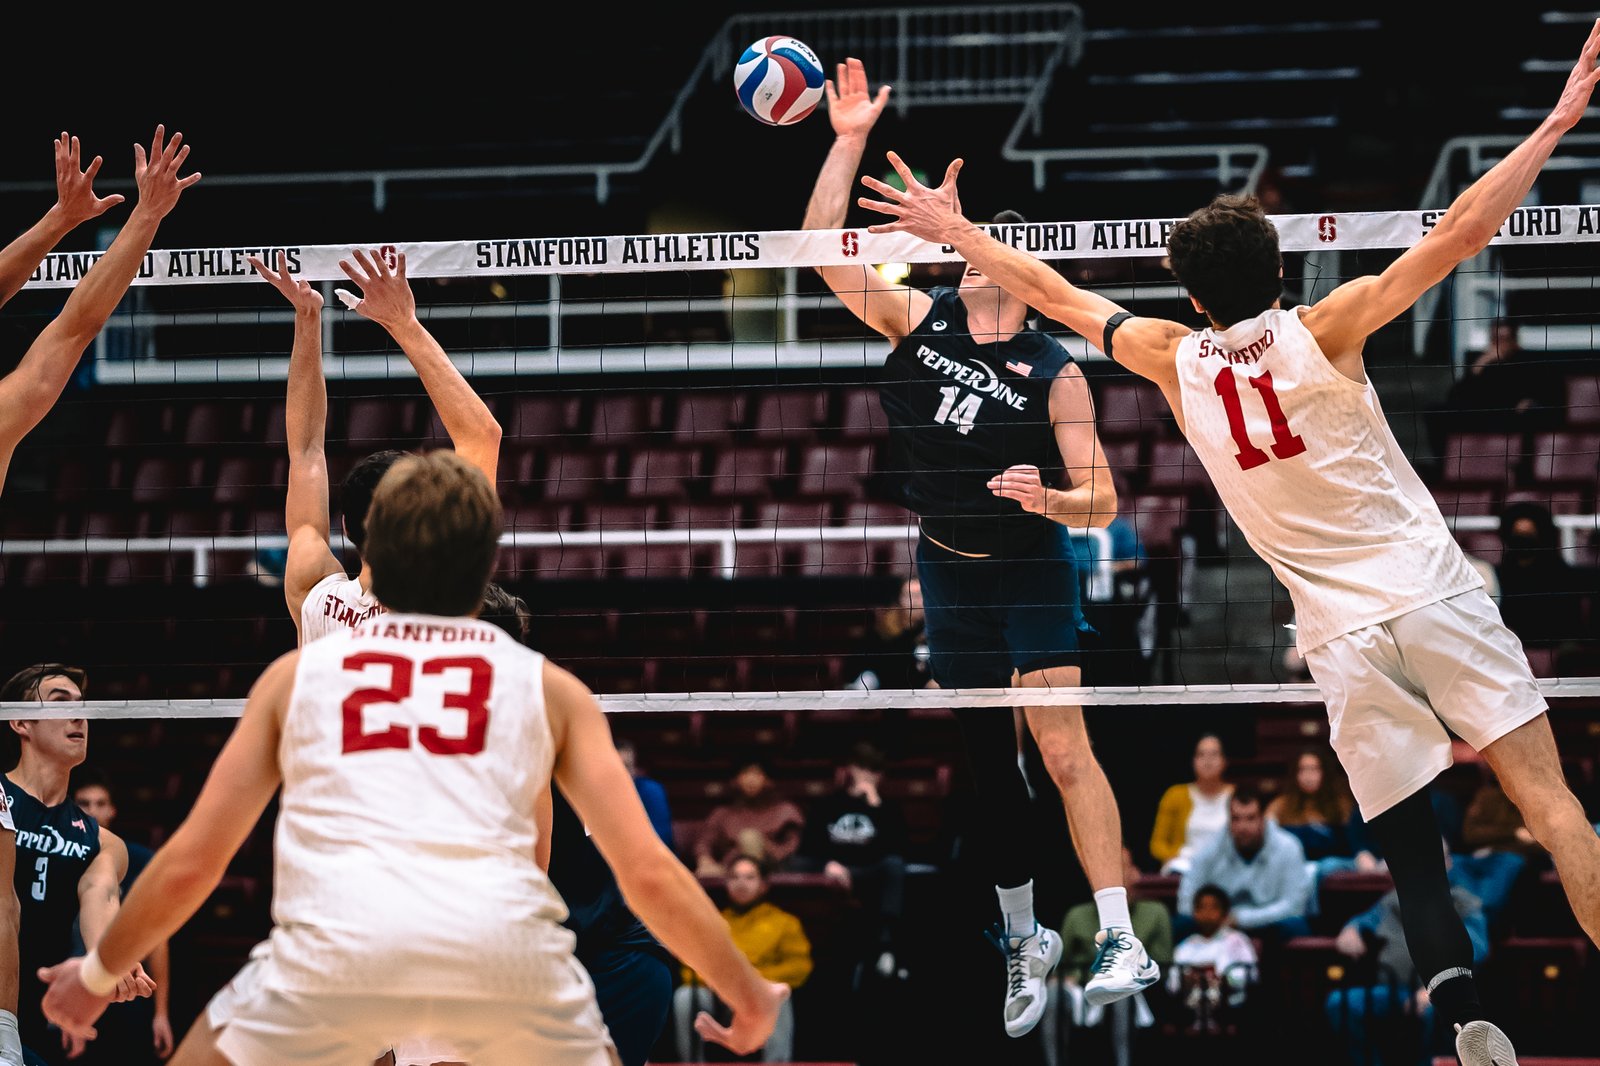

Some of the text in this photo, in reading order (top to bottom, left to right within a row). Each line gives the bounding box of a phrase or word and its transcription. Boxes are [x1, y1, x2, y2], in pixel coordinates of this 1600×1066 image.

[476, 233, 760, 268] STANFORD ATHLETICS
[916, 344, 1028, 411] PEPPERDINE
[933, 385, 984, 436] 14
[1214, 366, 1307, 471] 11
[341, 651, 494, 756] 23
[31, 856, 49, 901] 3
